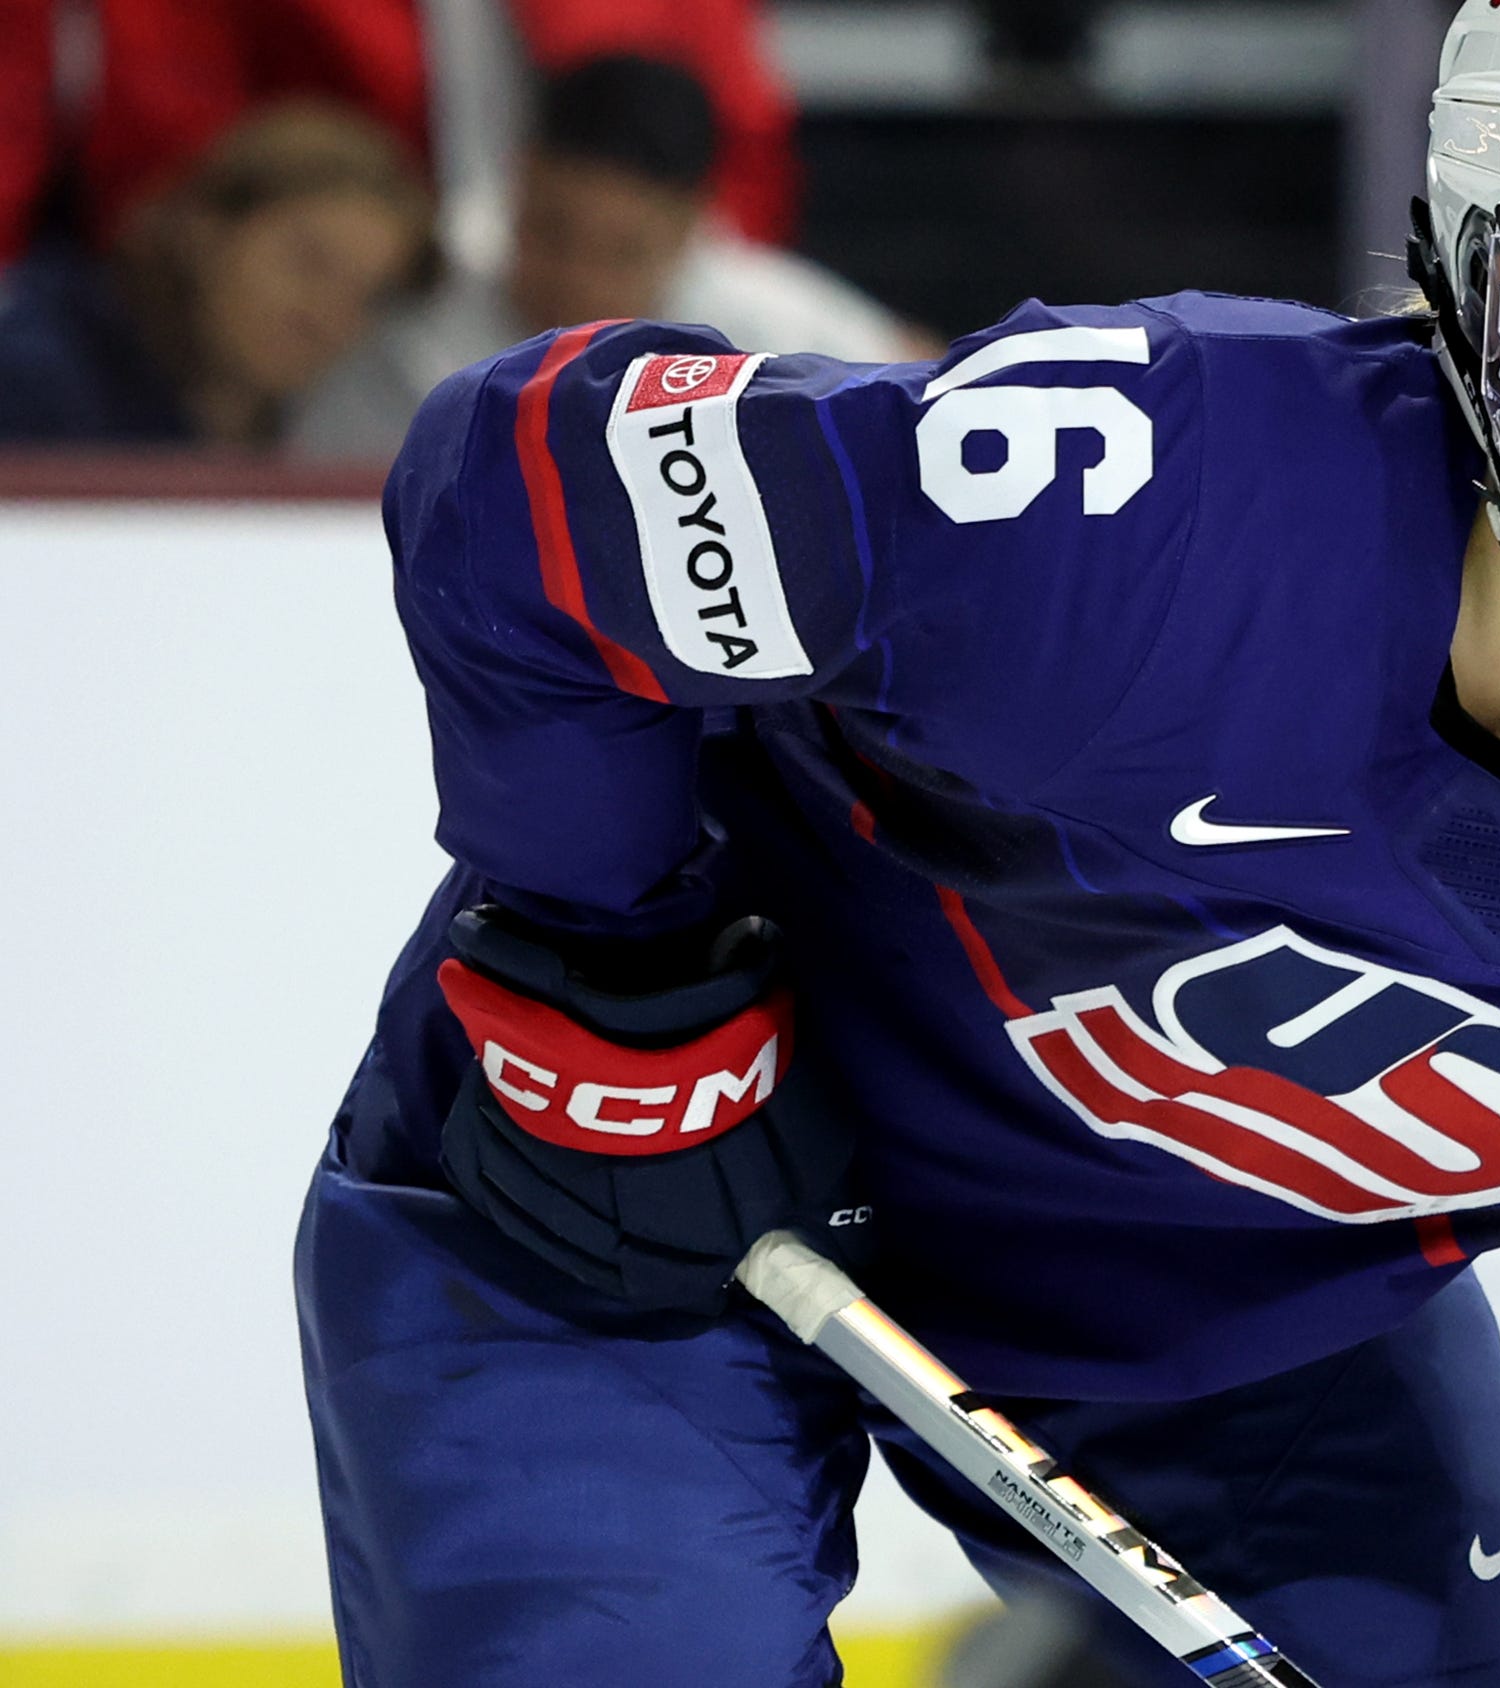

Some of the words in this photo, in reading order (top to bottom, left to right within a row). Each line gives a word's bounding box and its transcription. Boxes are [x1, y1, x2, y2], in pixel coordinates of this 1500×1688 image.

[915, 326, 1153, 524] 16
[648, 406, 759, 669] TOYOTA
[482, 1033, 778, 1136] CCM
[828, 1205, 873, 1226] CC
[995, 1469, 1087, 1551] NANOLITE
